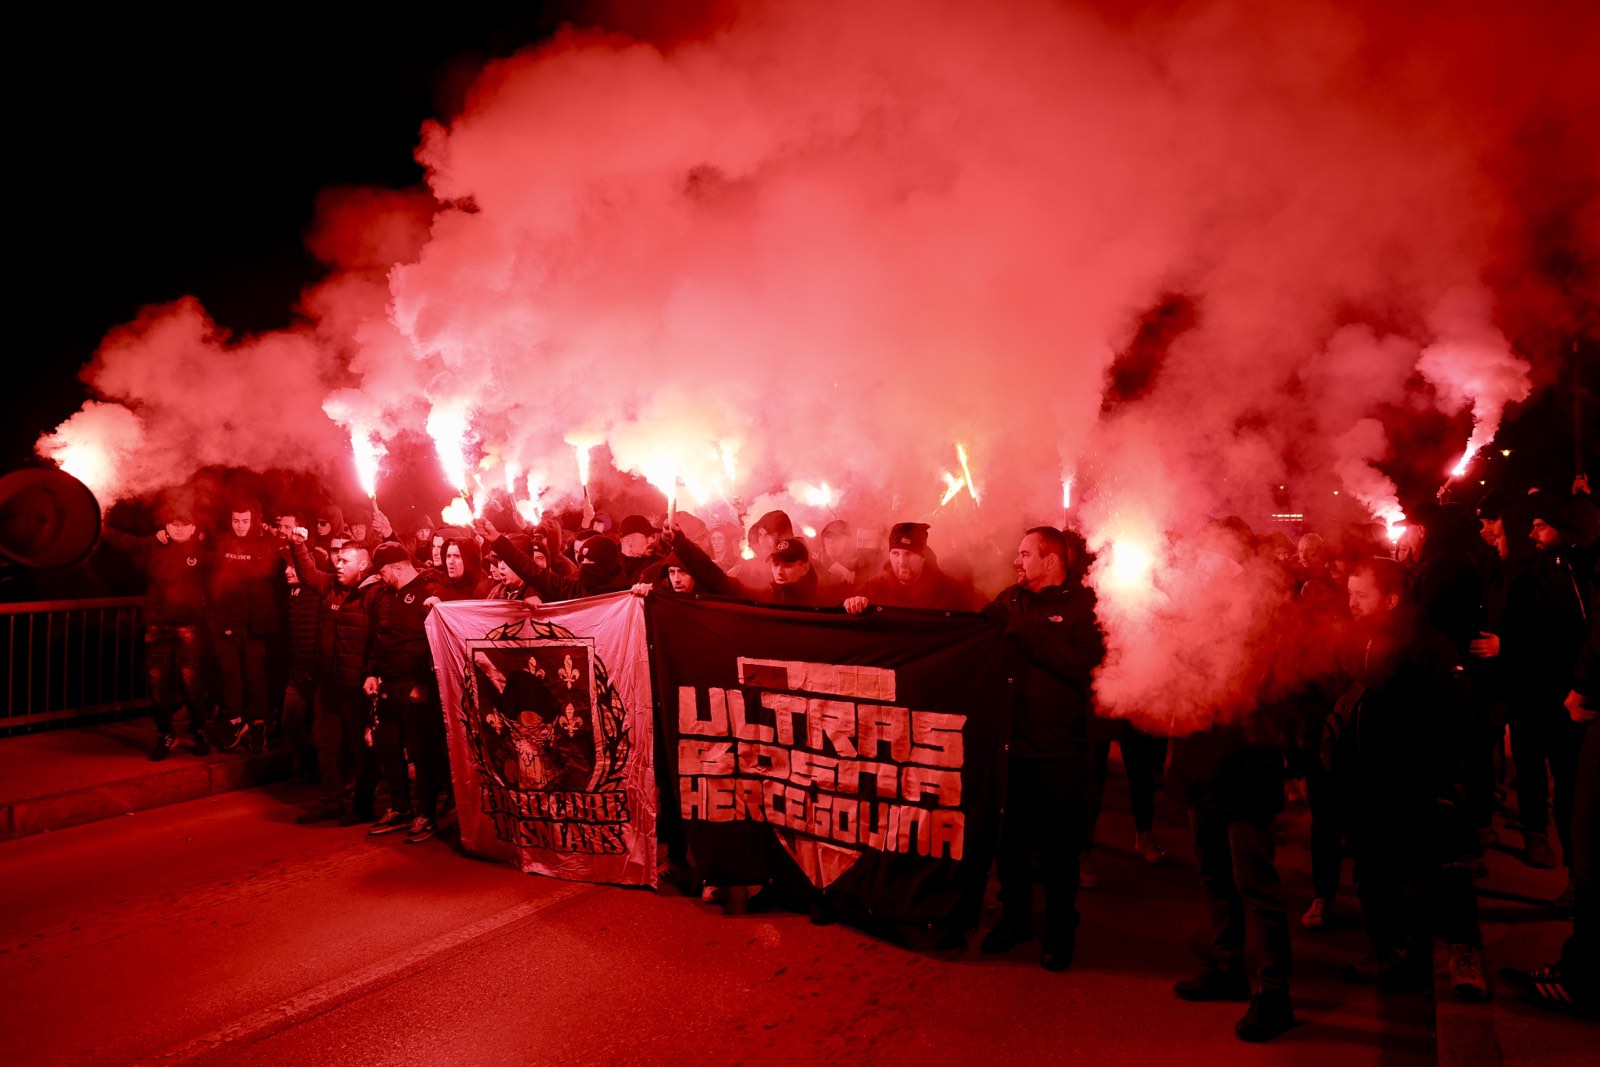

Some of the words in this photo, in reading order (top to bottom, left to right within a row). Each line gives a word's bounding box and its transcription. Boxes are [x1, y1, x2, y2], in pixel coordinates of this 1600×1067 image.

[679, 686, 967, 768] ULTRAS
[480, 784, 630, 823] HARDCORE
[678, 738, 964, 808] BOSNA
